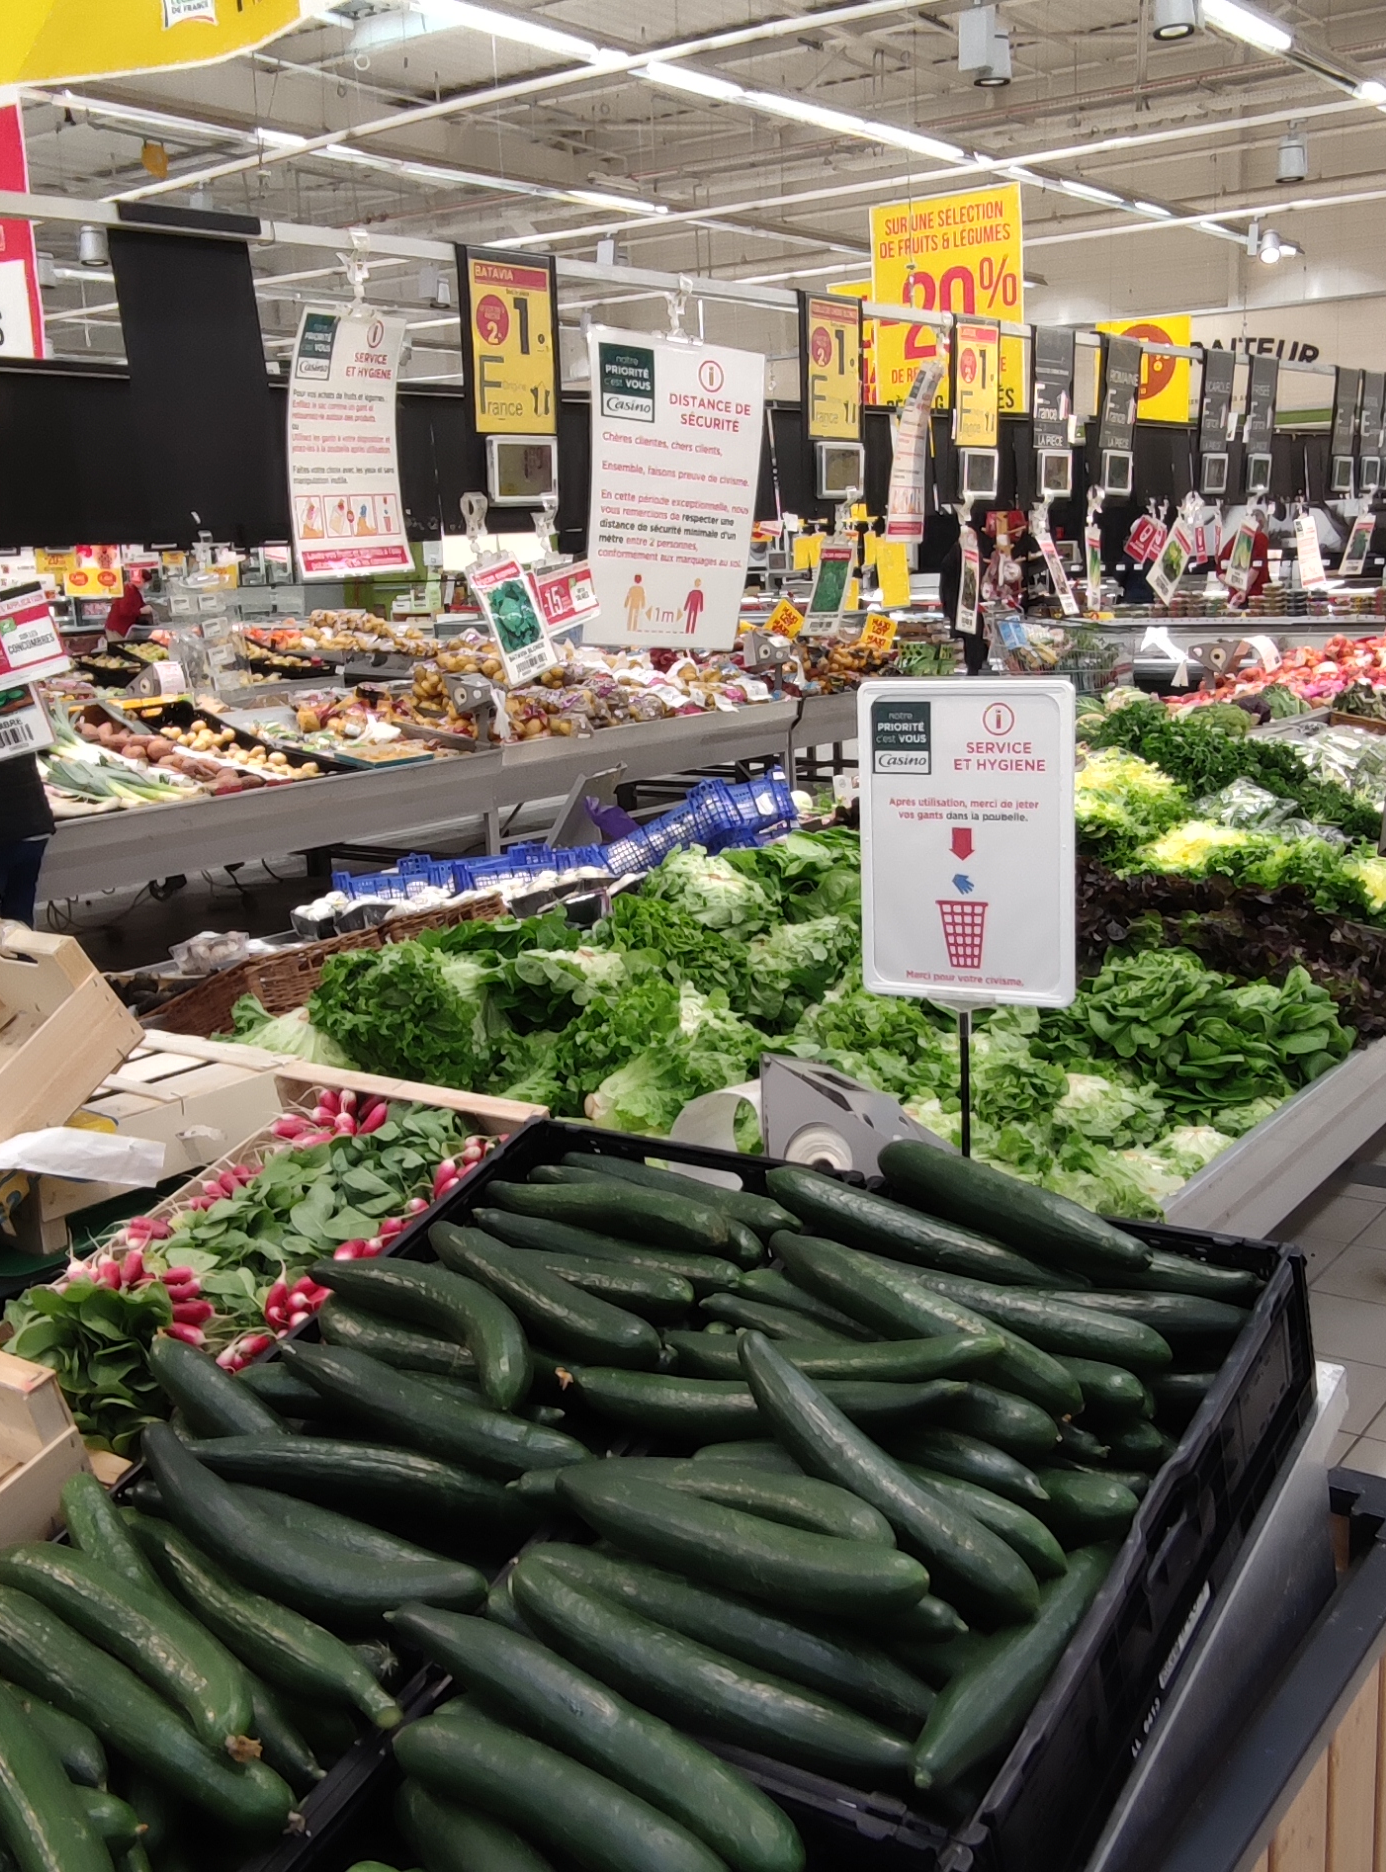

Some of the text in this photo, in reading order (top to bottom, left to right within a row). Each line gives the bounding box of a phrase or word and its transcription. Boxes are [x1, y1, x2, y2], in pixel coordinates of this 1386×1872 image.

[885, 200, 1004, 237] SUR UNE SÉLECTION
[879, 222, 1011, 259] DE FRUITS & LÉGUMES
[474, 265, 514, 281] BATAVIA
[354, 352, 388, 365] SERVICE
[346, 366, 392, 380] ET HYGIENE
[605, 364, 650, 380] PRIORITÉ
[625, 379, 652, 391] VOUS
[606, 396, 652, 415] Casino
[669, 393, 752, 416] DISTANCE DE
[680, 411, 740, 433] SÉCURITÉ
[602, 431, 633, 445] Chères
[671, 440, 693, 452] chers
[602, 460, 646, 475] Ensemble,
[647, 465, 676, 479] faisons
[678, 470, 706, 482] preuve
[708, 473, 718, 483] de
[601, 489, 612, 500] En
[614, 491, 636, 502] cette
[638, 494, 670, 507] période
[600, 505, 620, 515] vous
[670, 512, 681, 521] de
[681, 513, 719, 526] respecter
[720, 518, 735, 527] une
[599, 518, 737, 540] distance de sécurité minimale d'un
[598, 533, 624, 544] mètre
[626, 537, 648, 547] entre
[649, 537, 655, 548] 2
[660, 554, 674, 563] aux
[675, 555, 717, 567] marquages
[7, 632, 56, 655] CONCOMBRES
[888, 712, 913, 720] notre
[877, 720, 925, 732] PRIORITÉ
[875, 733, 927, 743] c'est VOUS
[966, 742, 1032, 754] SERVICE
[878, 753, 927, 767] Casino
[954, 759, 1046, 772] ET HYGIENE
[889, 797, 1040, 811] Après utilisation, merci de jeter
[898, 810, 1029, 822] vos gants dans la poubelle.
[906, 970, 1025, 987] Merci pour votre civisme.
